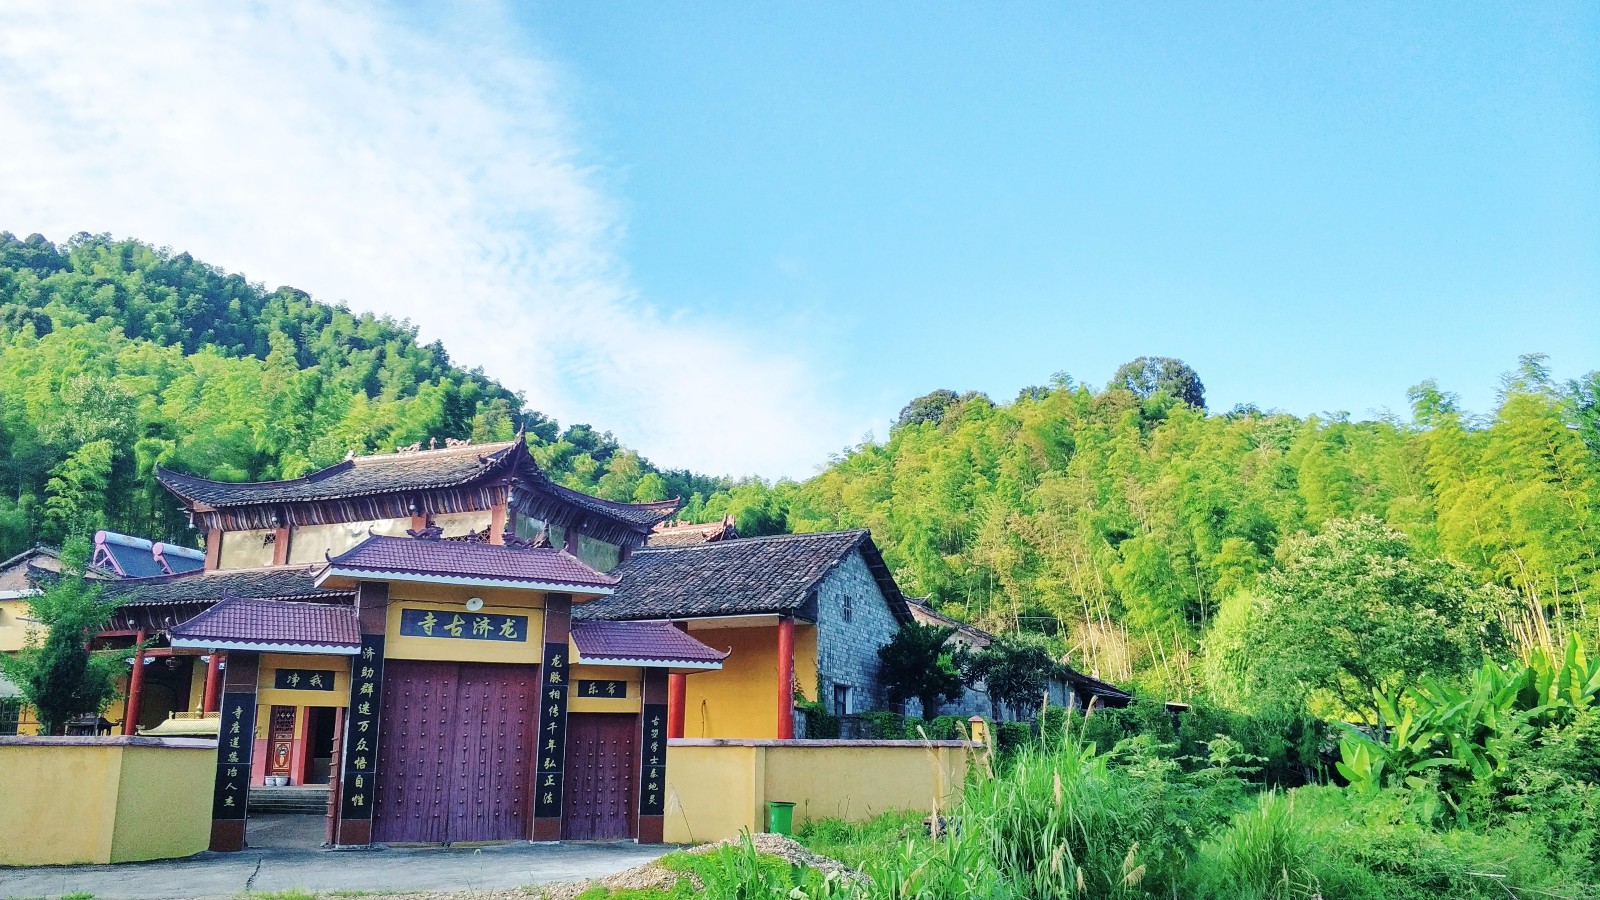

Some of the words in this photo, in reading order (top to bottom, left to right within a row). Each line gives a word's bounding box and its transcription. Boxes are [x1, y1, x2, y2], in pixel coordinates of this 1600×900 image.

[417, 611, 518, 639] 龙济古寺
[543, 654, 563, 806] 龙脉相传千年弘正法
